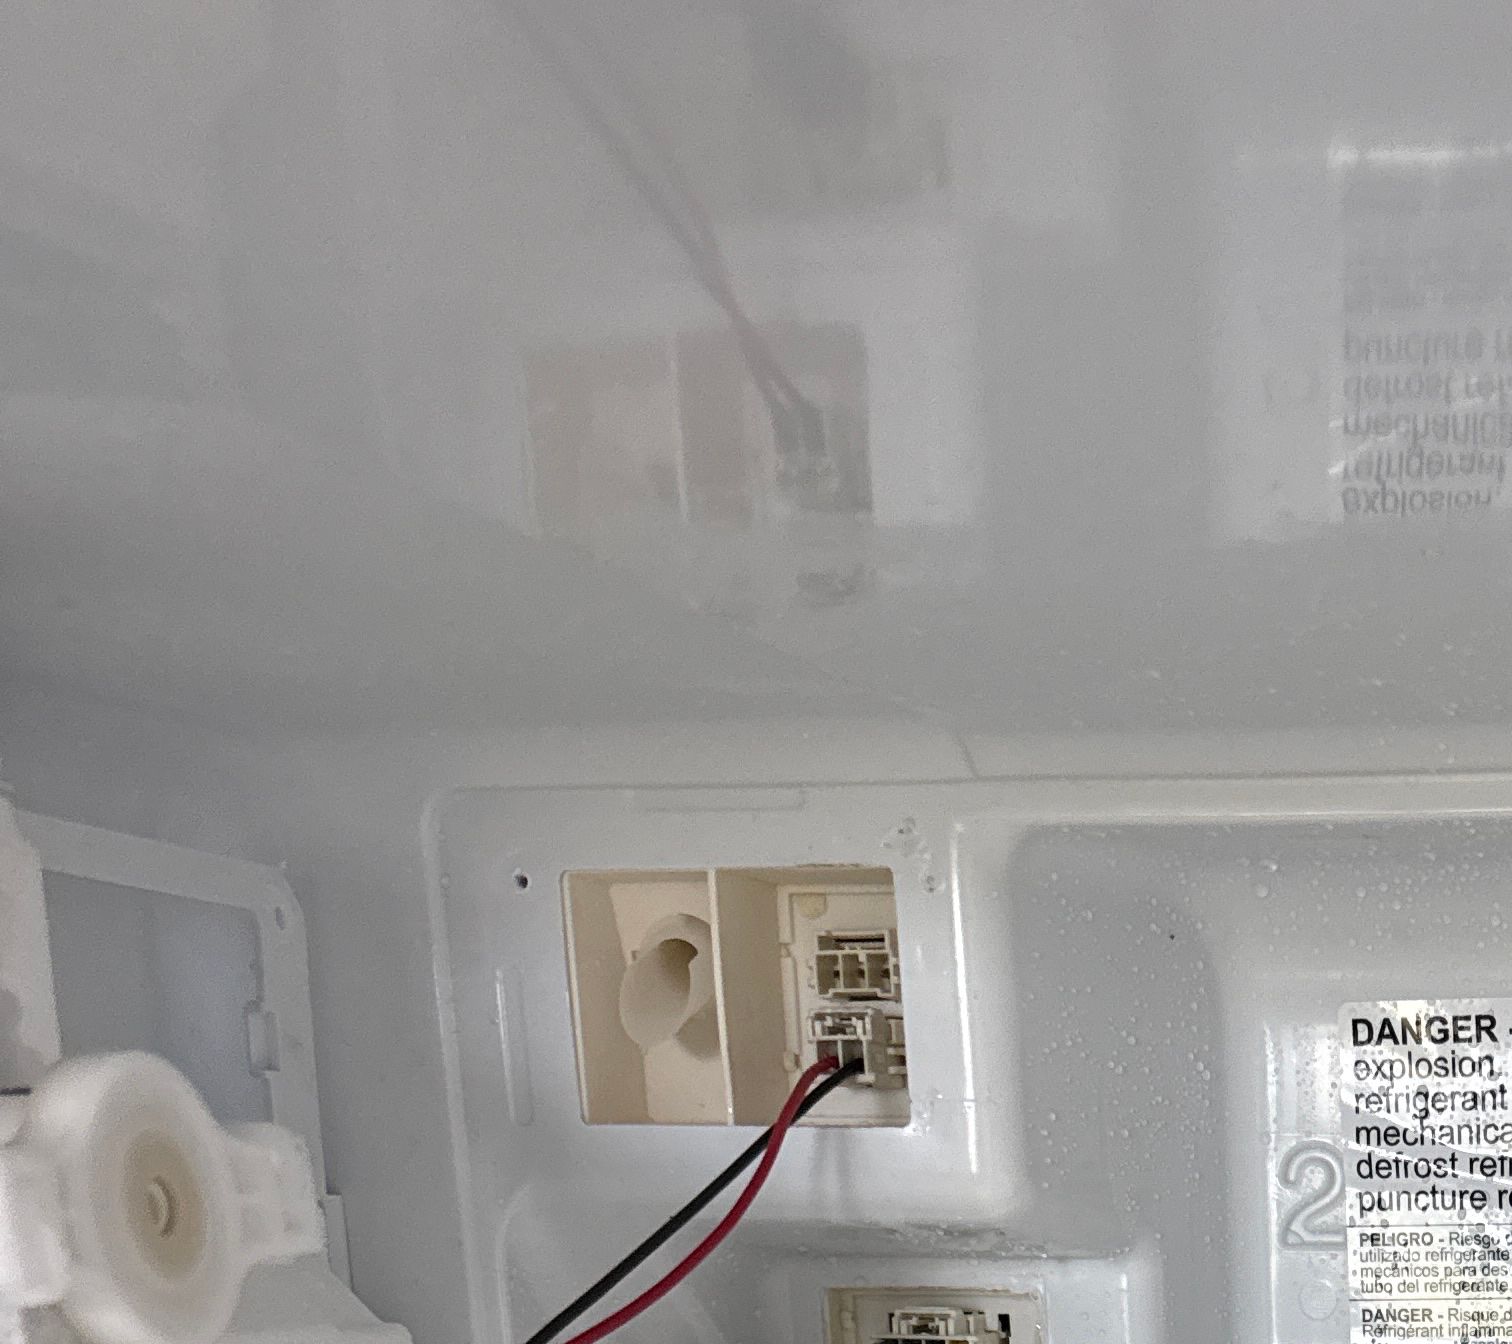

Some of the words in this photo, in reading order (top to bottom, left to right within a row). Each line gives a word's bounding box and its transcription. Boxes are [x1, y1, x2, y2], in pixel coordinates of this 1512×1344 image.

[1352, 1014, 1498, 1046] DANGER
[1354, 1083, 1508, 1119] refrigerant
[1356, 1150, 1459, 1180] defrost
[1278, 1138, 1347, 1248] 2
[1359, 1184, 1488, 1219] puncture
[1360, 1232, 1434, 1247] PELIGRO
[1360, 1247, 1420, 1263] utilizado
[1425, 1246, 1510, 1265] refrigerante
[1444, 1263, 1477, 1280] para
[1361, 1280, 1392, 1295] tubo
[1397, 1279, 1419, 1293] del
[1361, 1308, 1433, 1323] DANGER
[1448, 1307, 1499, 1324] Risque
